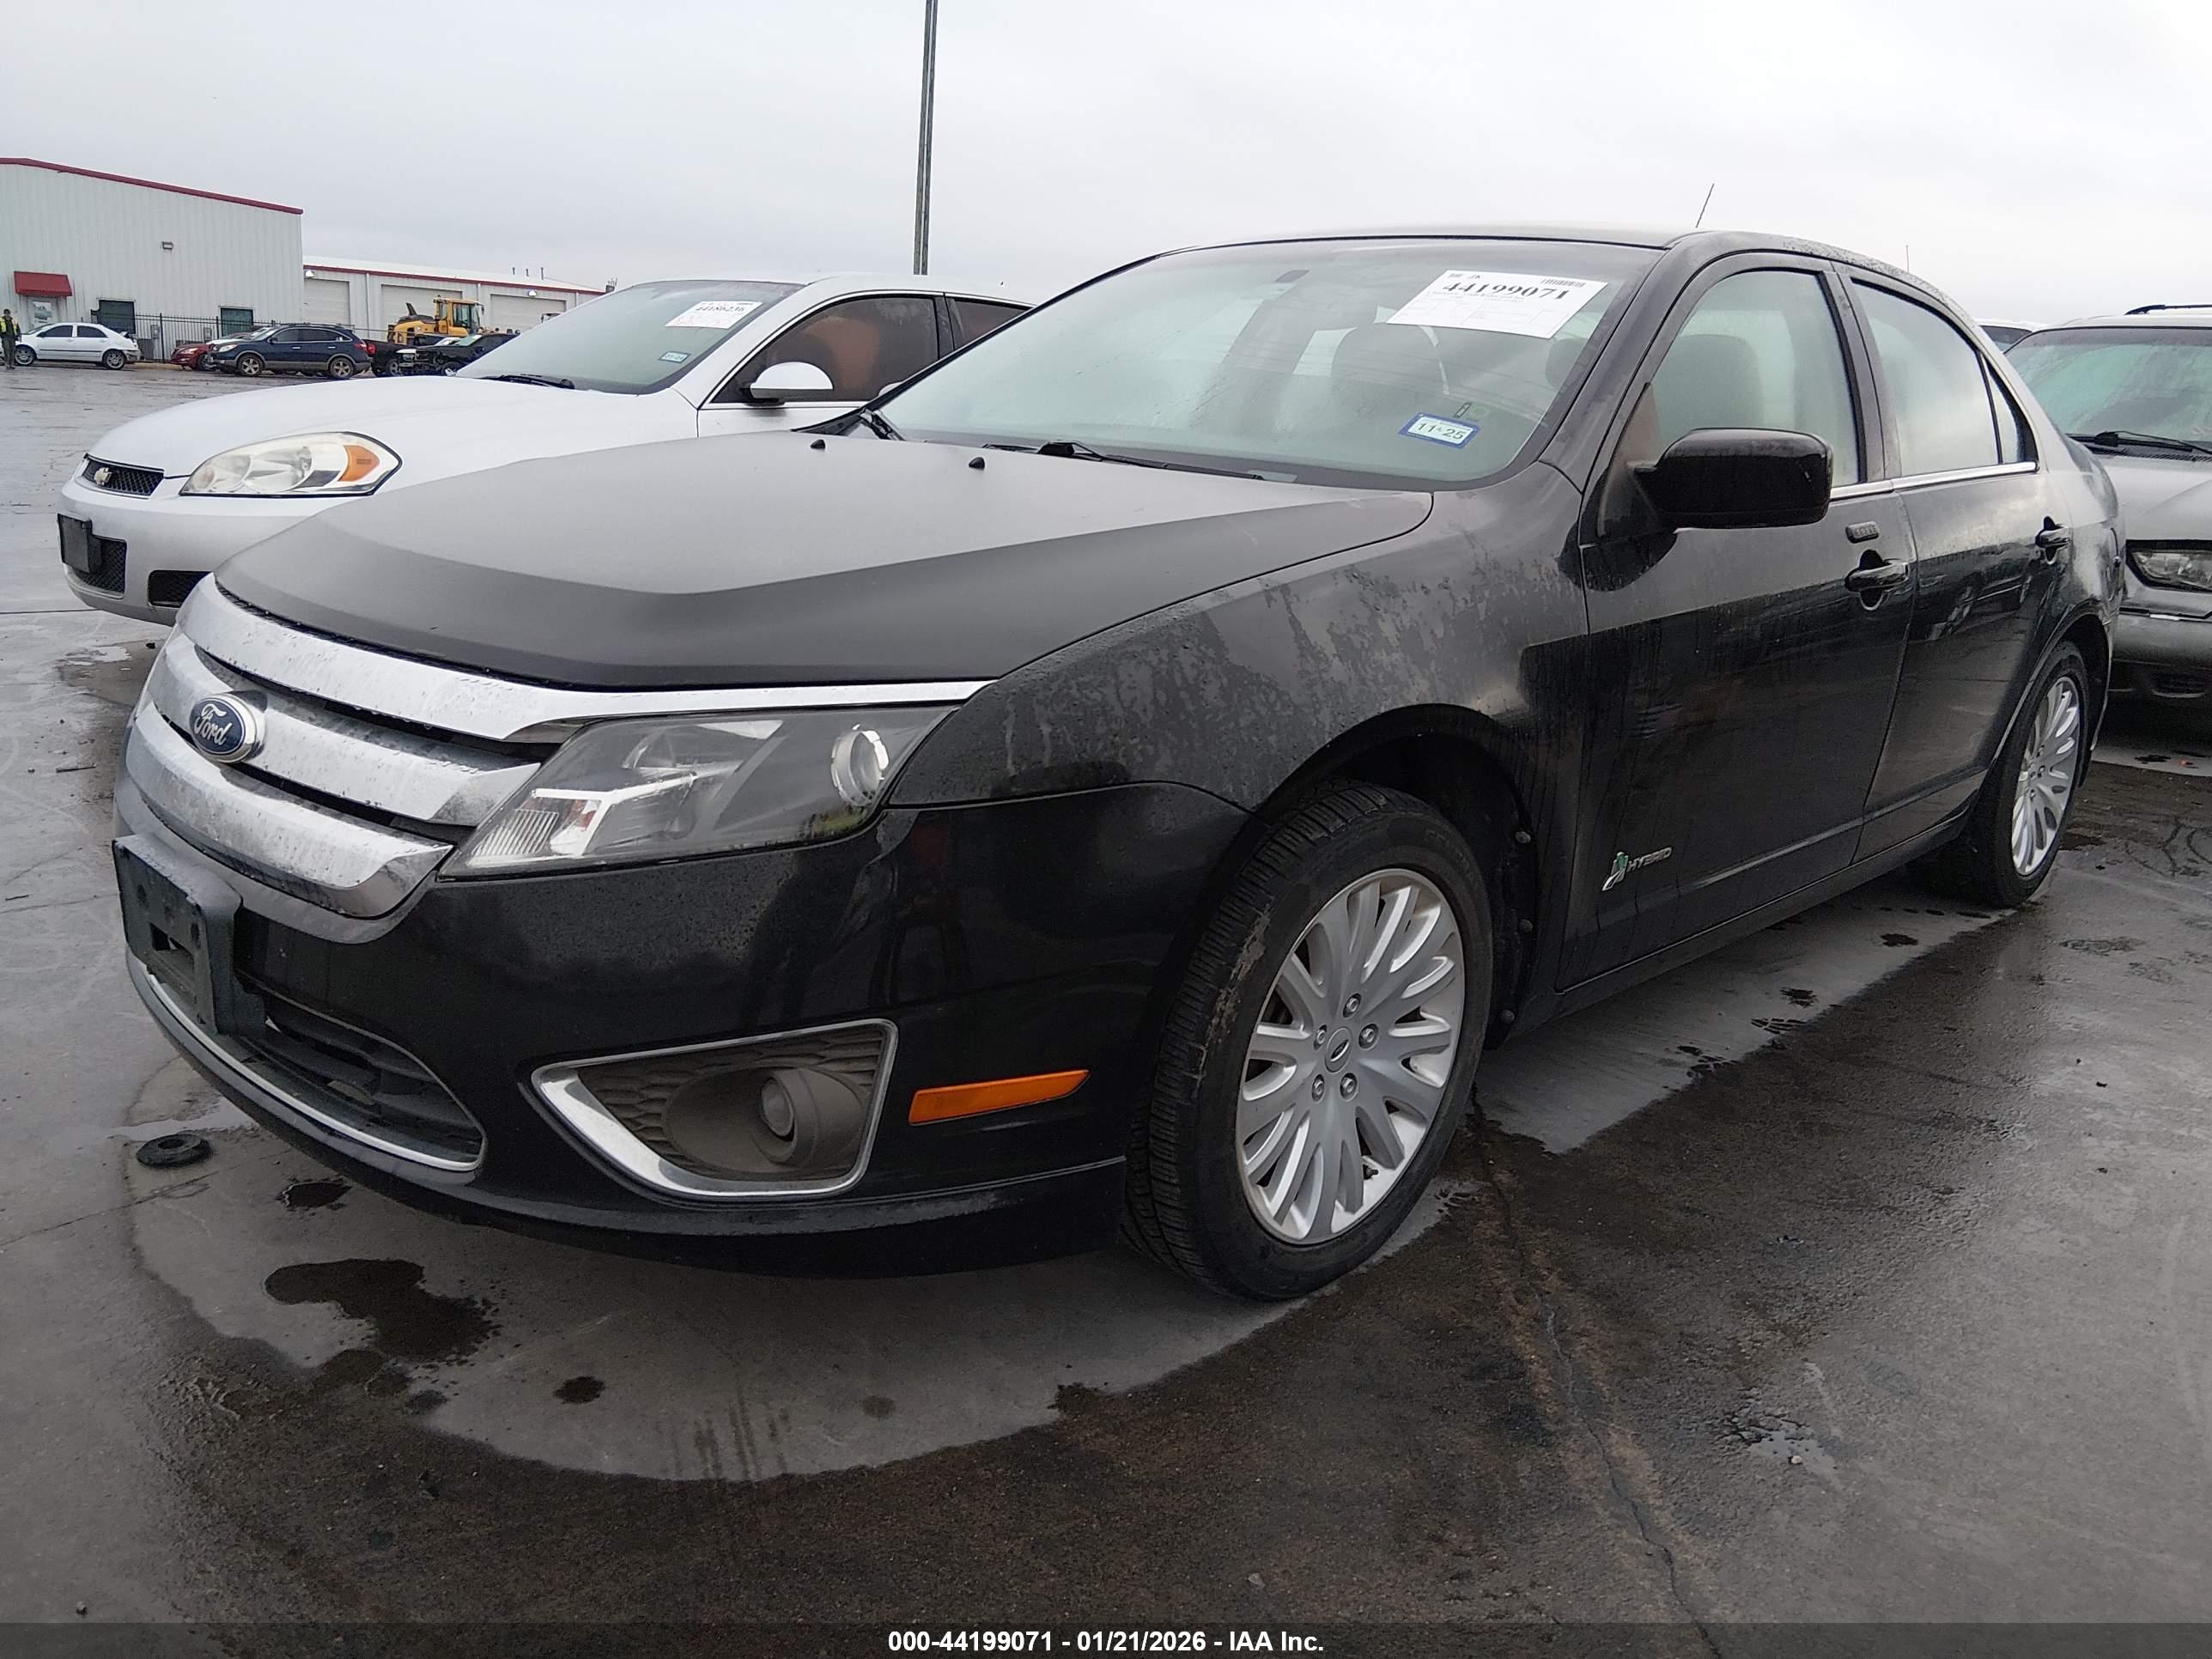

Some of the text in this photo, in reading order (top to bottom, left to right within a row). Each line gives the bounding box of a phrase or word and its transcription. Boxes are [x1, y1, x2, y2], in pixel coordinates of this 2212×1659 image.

[1443, 282, 1570, 301] 44199071
[1418, 422, 1467, 440] 11 25
[193, 703, 233, 745] Ford
[1626, 847, 1673, 872] HYBRID
